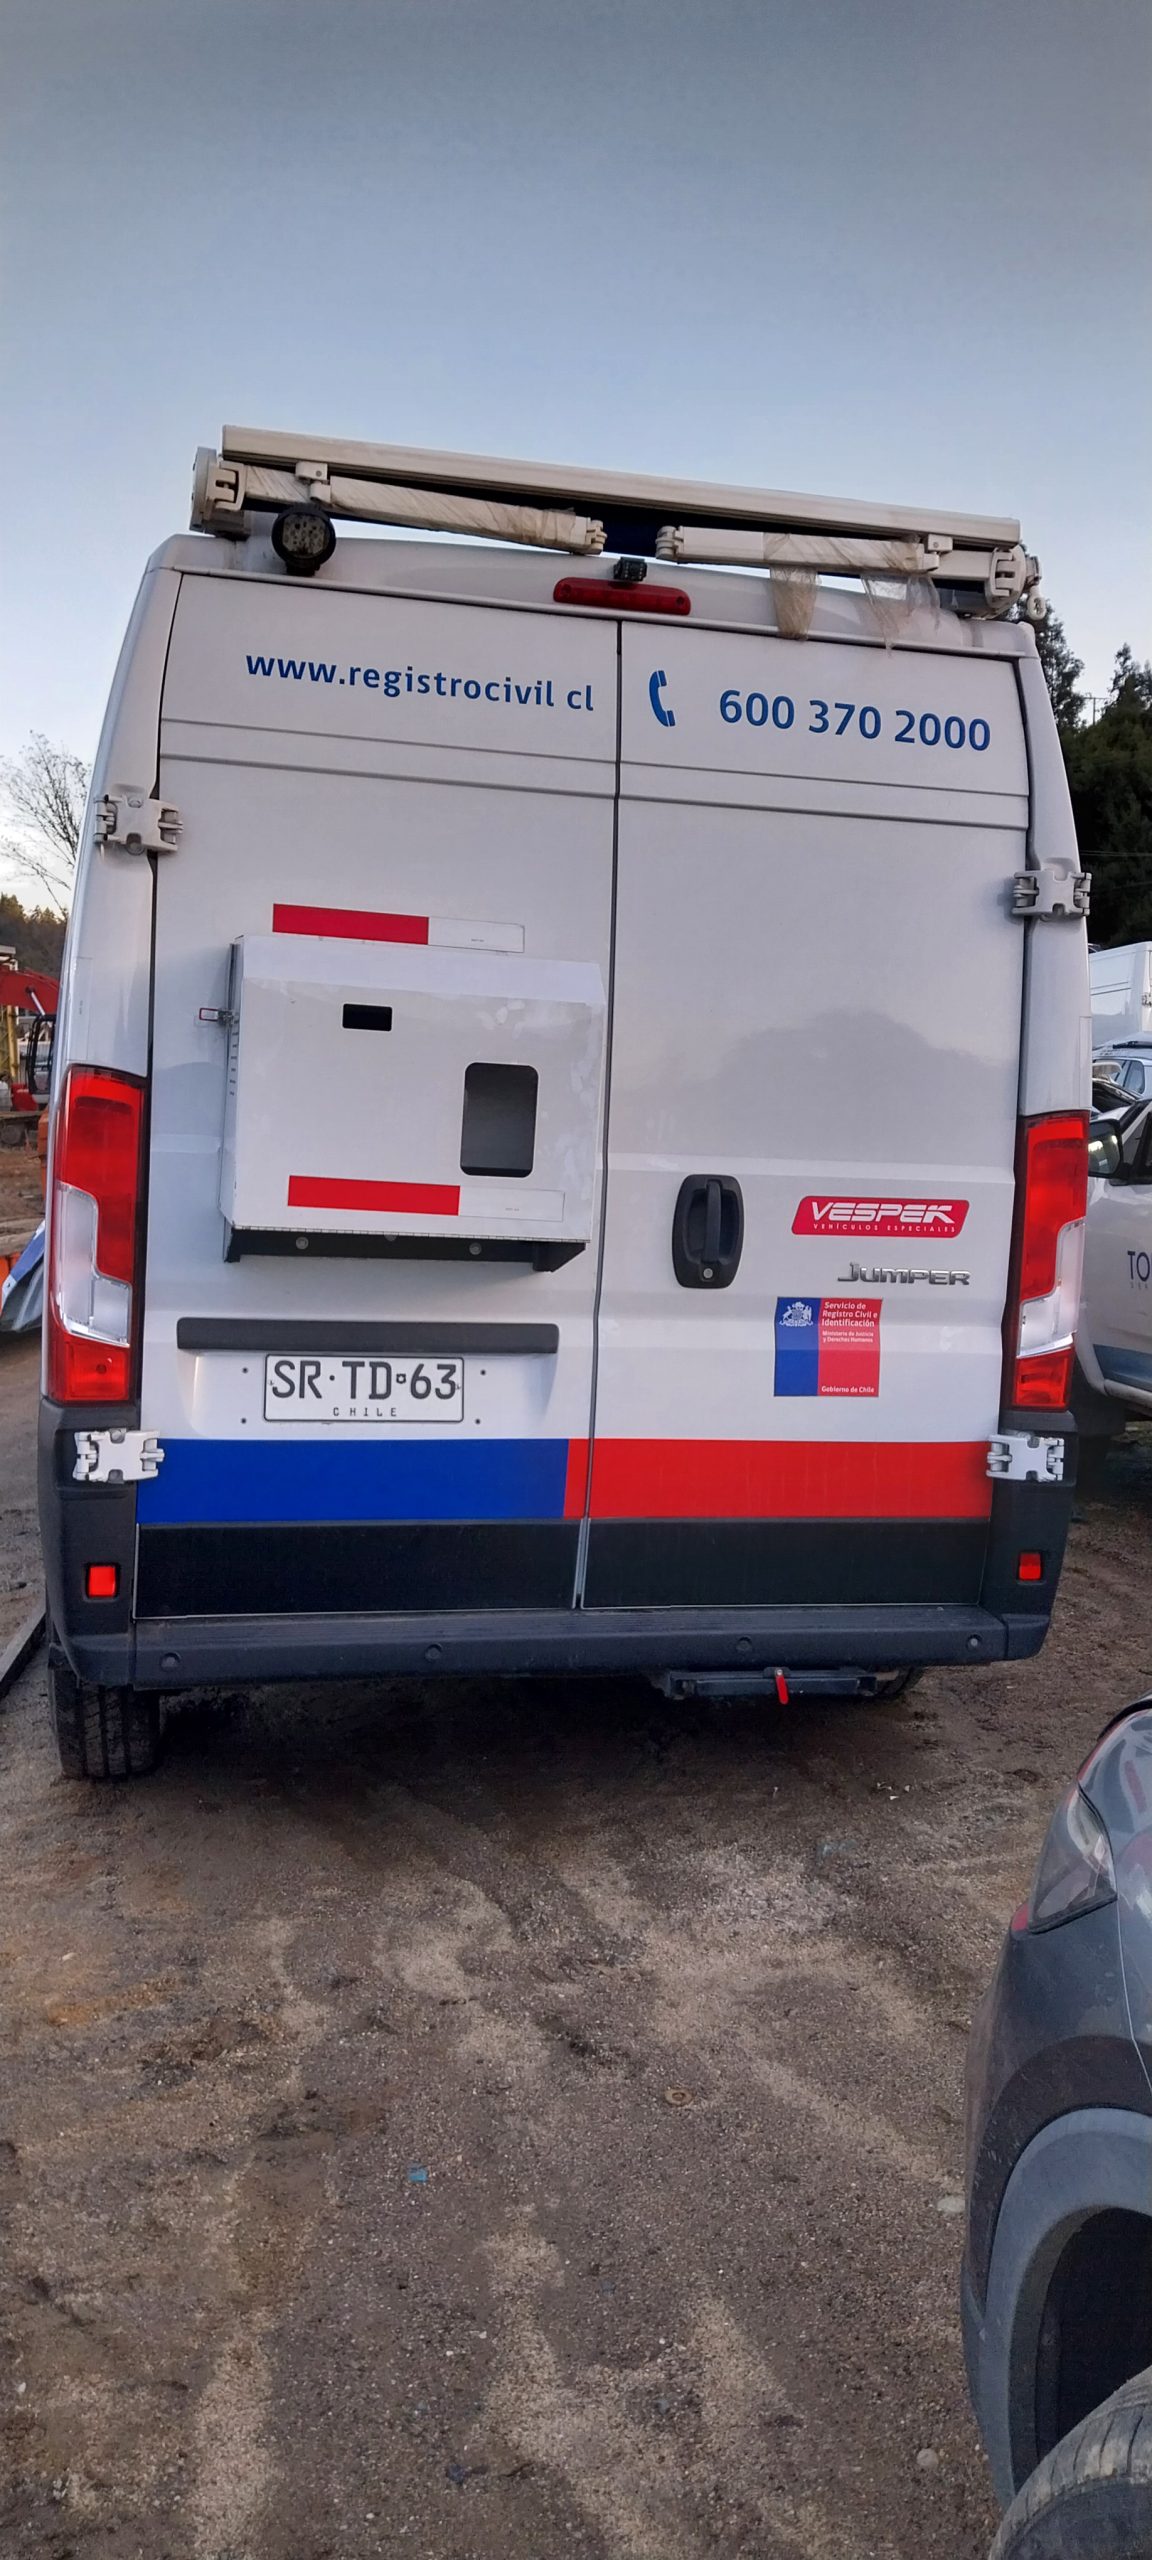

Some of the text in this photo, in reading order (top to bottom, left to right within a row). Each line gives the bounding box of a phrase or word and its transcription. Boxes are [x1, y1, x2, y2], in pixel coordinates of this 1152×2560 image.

[246, 654, 593, 711] www.registrocivil cl
[719, 689, 991, 751] 600 370 2000
[811, 1201, 955, 1224] VESPEK
[887, 1225, 955, 1233] ESPECIALES
[1127, 1251, 1152, 1281] TO
[824, 1301, 866, 1310] Servicio de
[822, 1310, 853, 1319] Registro
[821, 1318, 875, 1327] Identificación
[333, 1407, 397, 1417] CHILE
